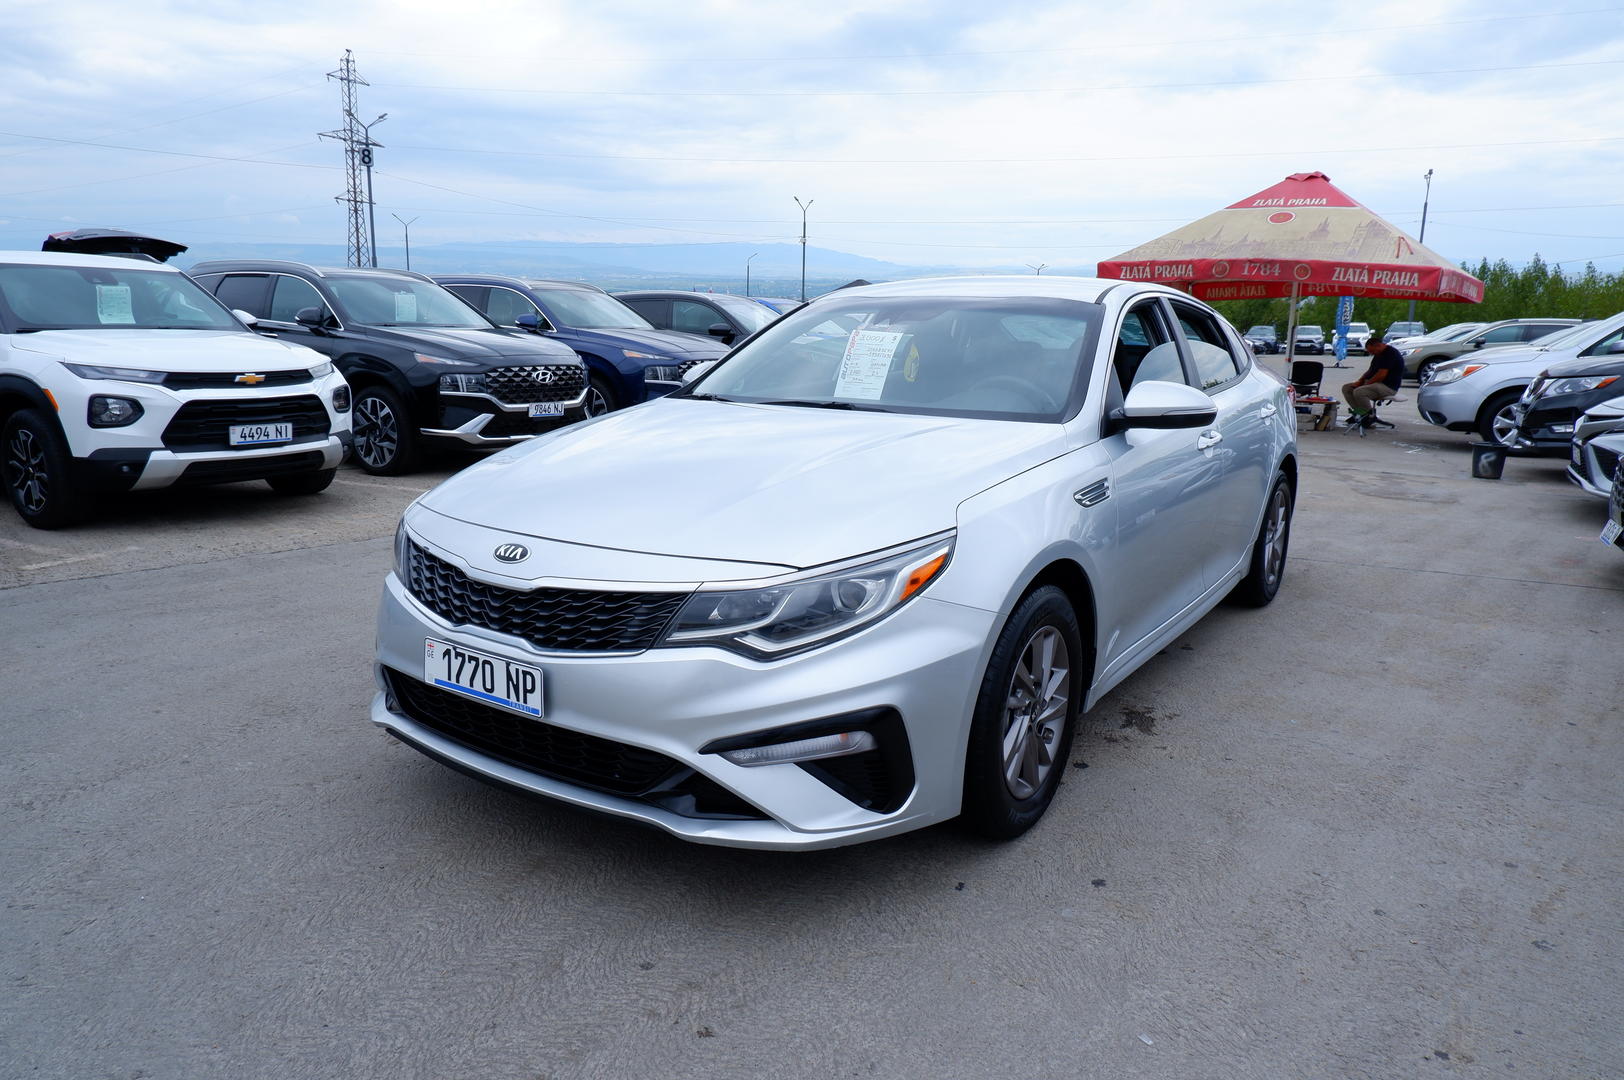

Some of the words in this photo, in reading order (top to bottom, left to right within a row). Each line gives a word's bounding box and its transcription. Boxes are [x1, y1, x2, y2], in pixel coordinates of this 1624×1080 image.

[362, 149, 371, 164] 8
[1252, 197, 1285, 206] ZLATÁ
[1120, 262, 1151, 279] ZLATÁ
[1155, 264, 1193, 278] PRAHA
[1241, 263, 1280, 276] 1784
[1332, 266, 1369, 283] ZLATÁ
[1373, 271, 1419, 287] PRAHA
[240, 427, 270, 440] 4494
[275, 425, 288, 438] NI
[496, 544, 523, 559] KIA
[426, 650, 434, 659] GE
[443, 648, 495, 694] 1770
[505, 661, 536, 704] NP
